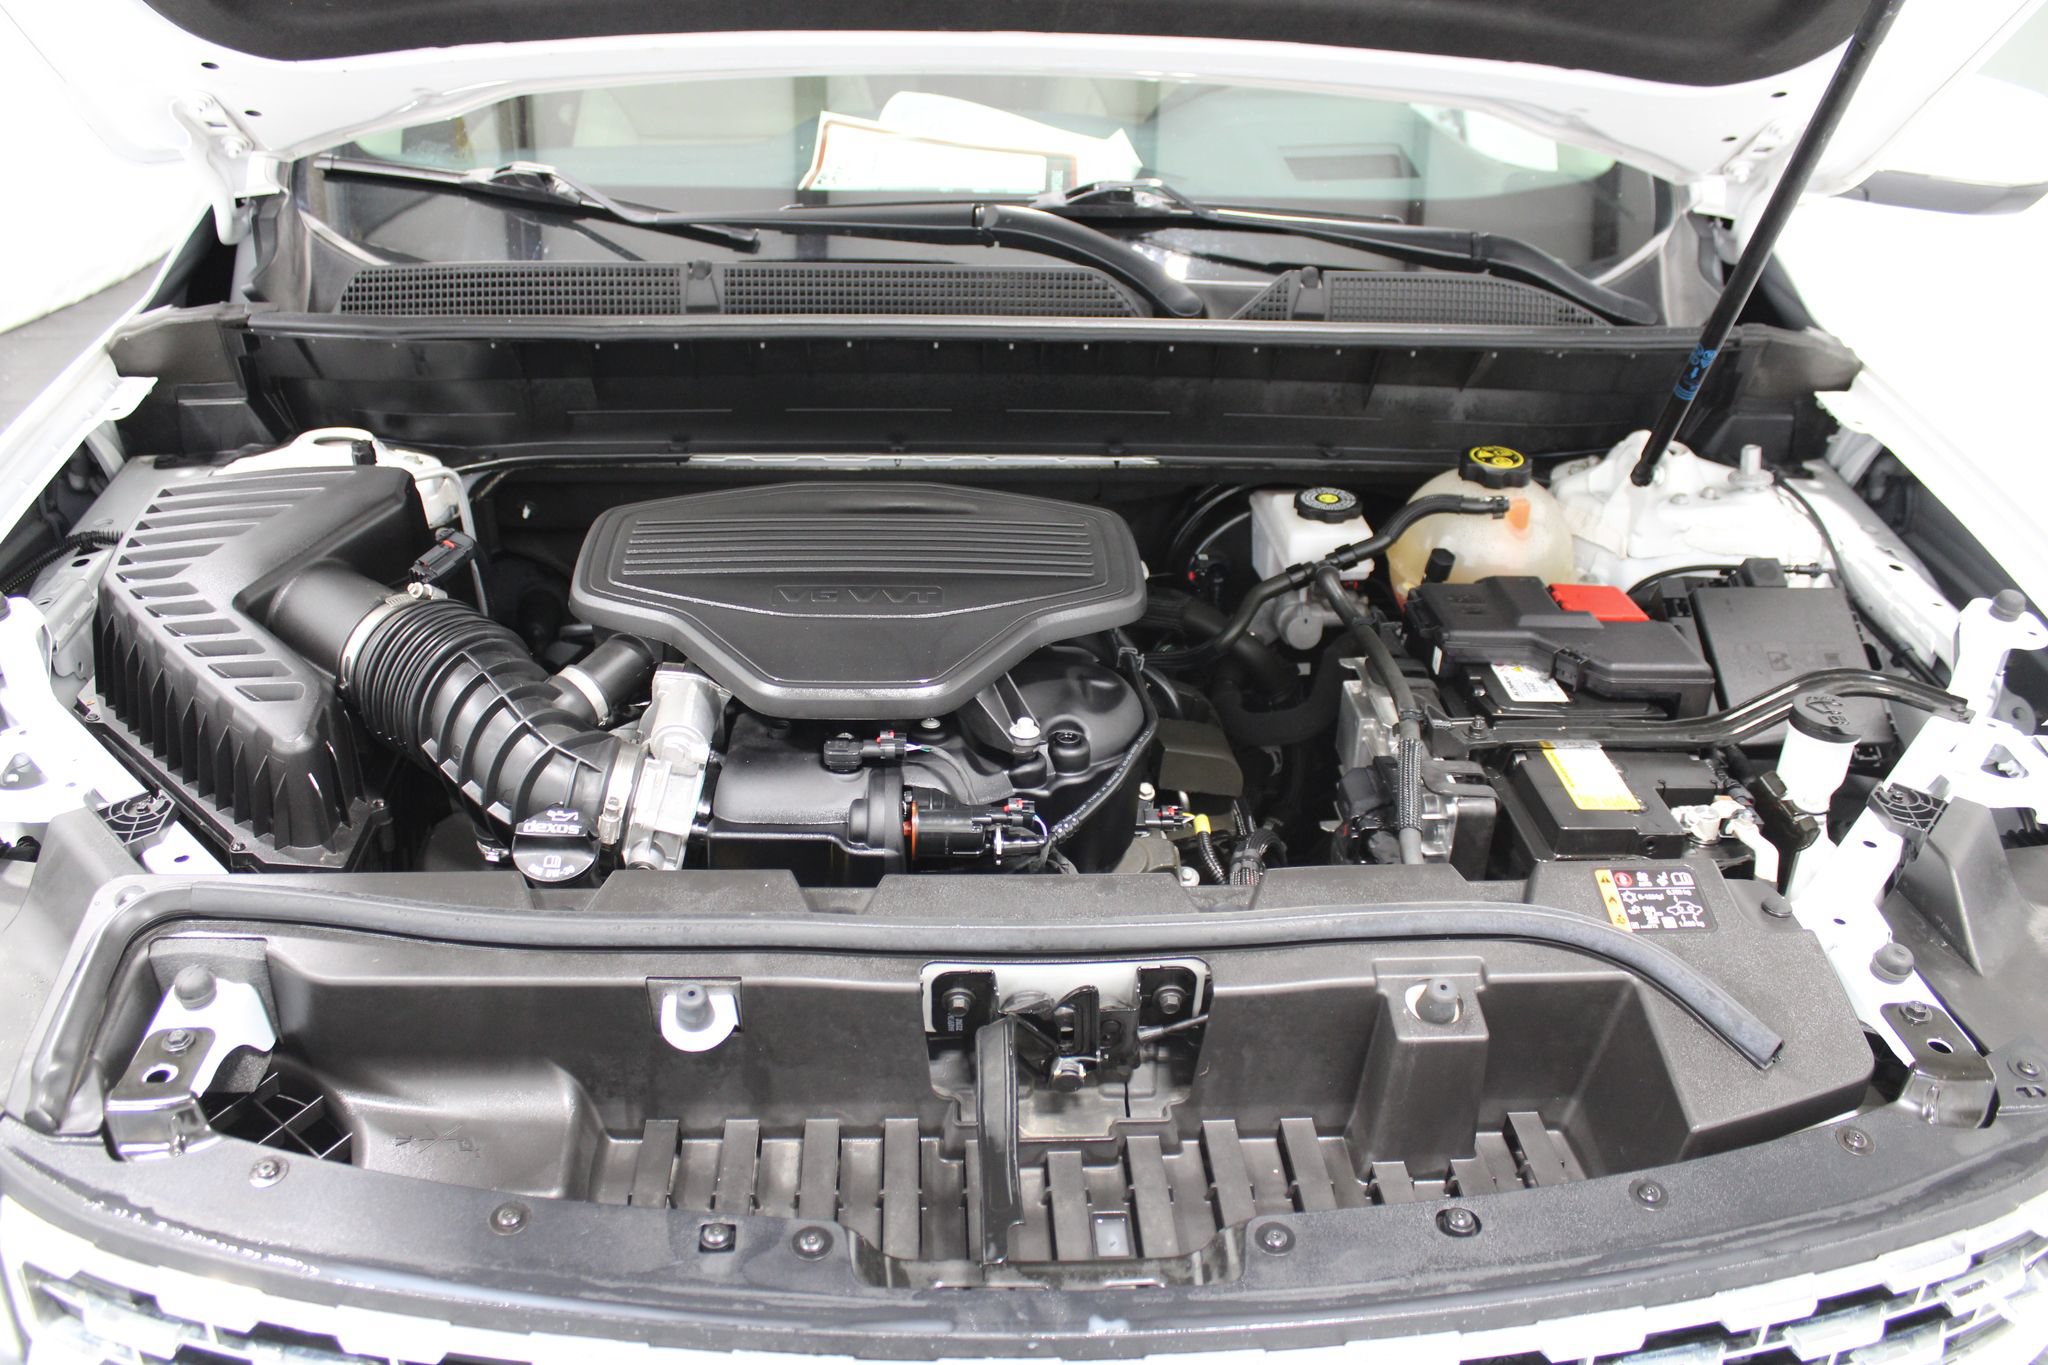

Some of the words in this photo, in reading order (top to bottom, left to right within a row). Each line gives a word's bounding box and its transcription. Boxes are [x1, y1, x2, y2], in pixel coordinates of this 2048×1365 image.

[778, 589, 838, 603] V6
[848, 589, 938, 604] VVT
[523, 820, 582, 835] dexos
